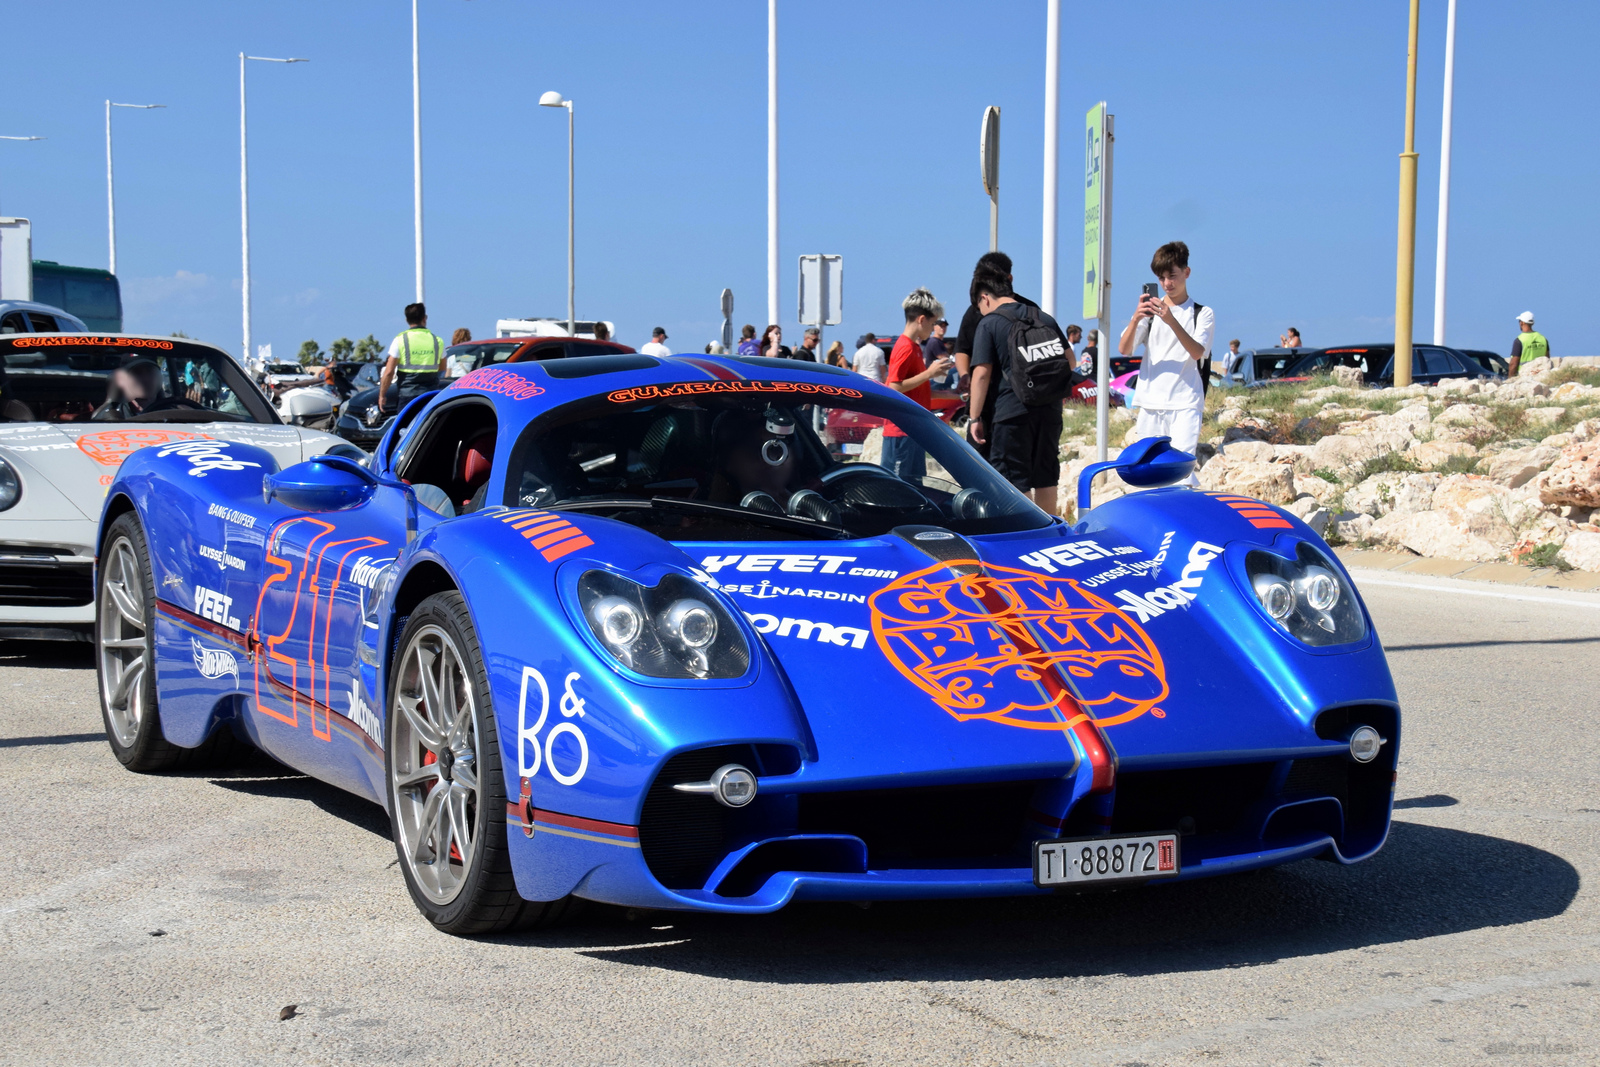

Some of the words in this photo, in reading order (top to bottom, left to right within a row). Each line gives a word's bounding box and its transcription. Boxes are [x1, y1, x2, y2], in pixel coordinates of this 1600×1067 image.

[12, 336, 174, 350] GUMBALL3000
[1018, 337, 1065, 363] VANS
[607, 381, 863, 403] GUMBALL3000
[208, 503, 229, 519] BANG
[230, 510, 257, 529] OLUFSEN
[199, 544, 223, 562] ULYSSE
[224, 553, 246, 571] NARDIN
[700, 554, 899, 579] YEET.com
[1082, 567, 1125, 588] ULYSSE
[771, 586, 866, 604] NARDIN
